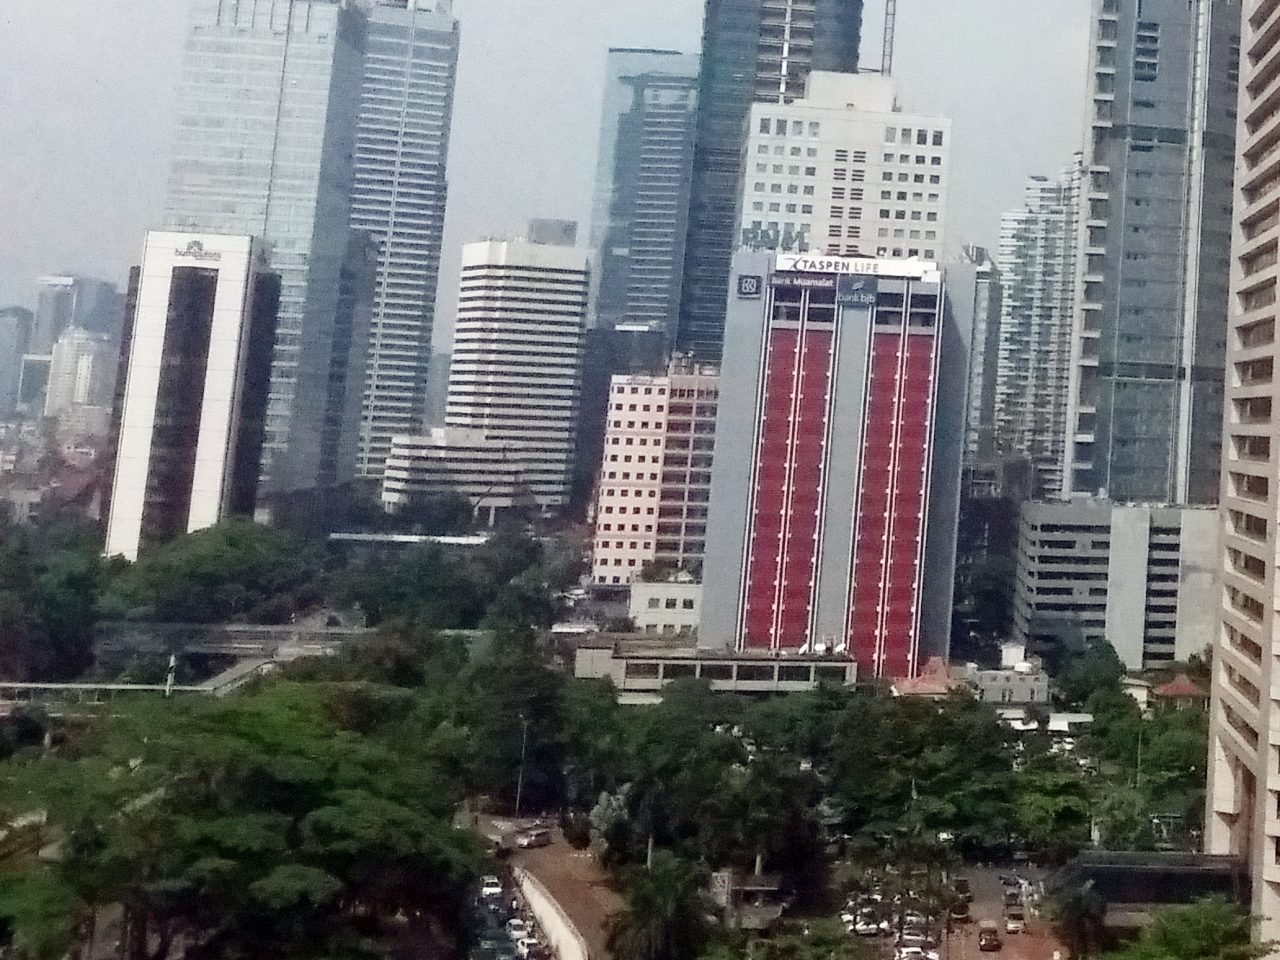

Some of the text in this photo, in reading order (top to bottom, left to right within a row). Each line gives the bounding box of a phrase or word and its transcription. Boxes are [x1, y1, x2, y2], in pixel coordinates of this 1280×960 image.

[802, 259, 880, 273] TASPEN LIFE
[771, 276, 834, 288] Bank Muamalat
[838, 292, 876, 305] bank bjb
